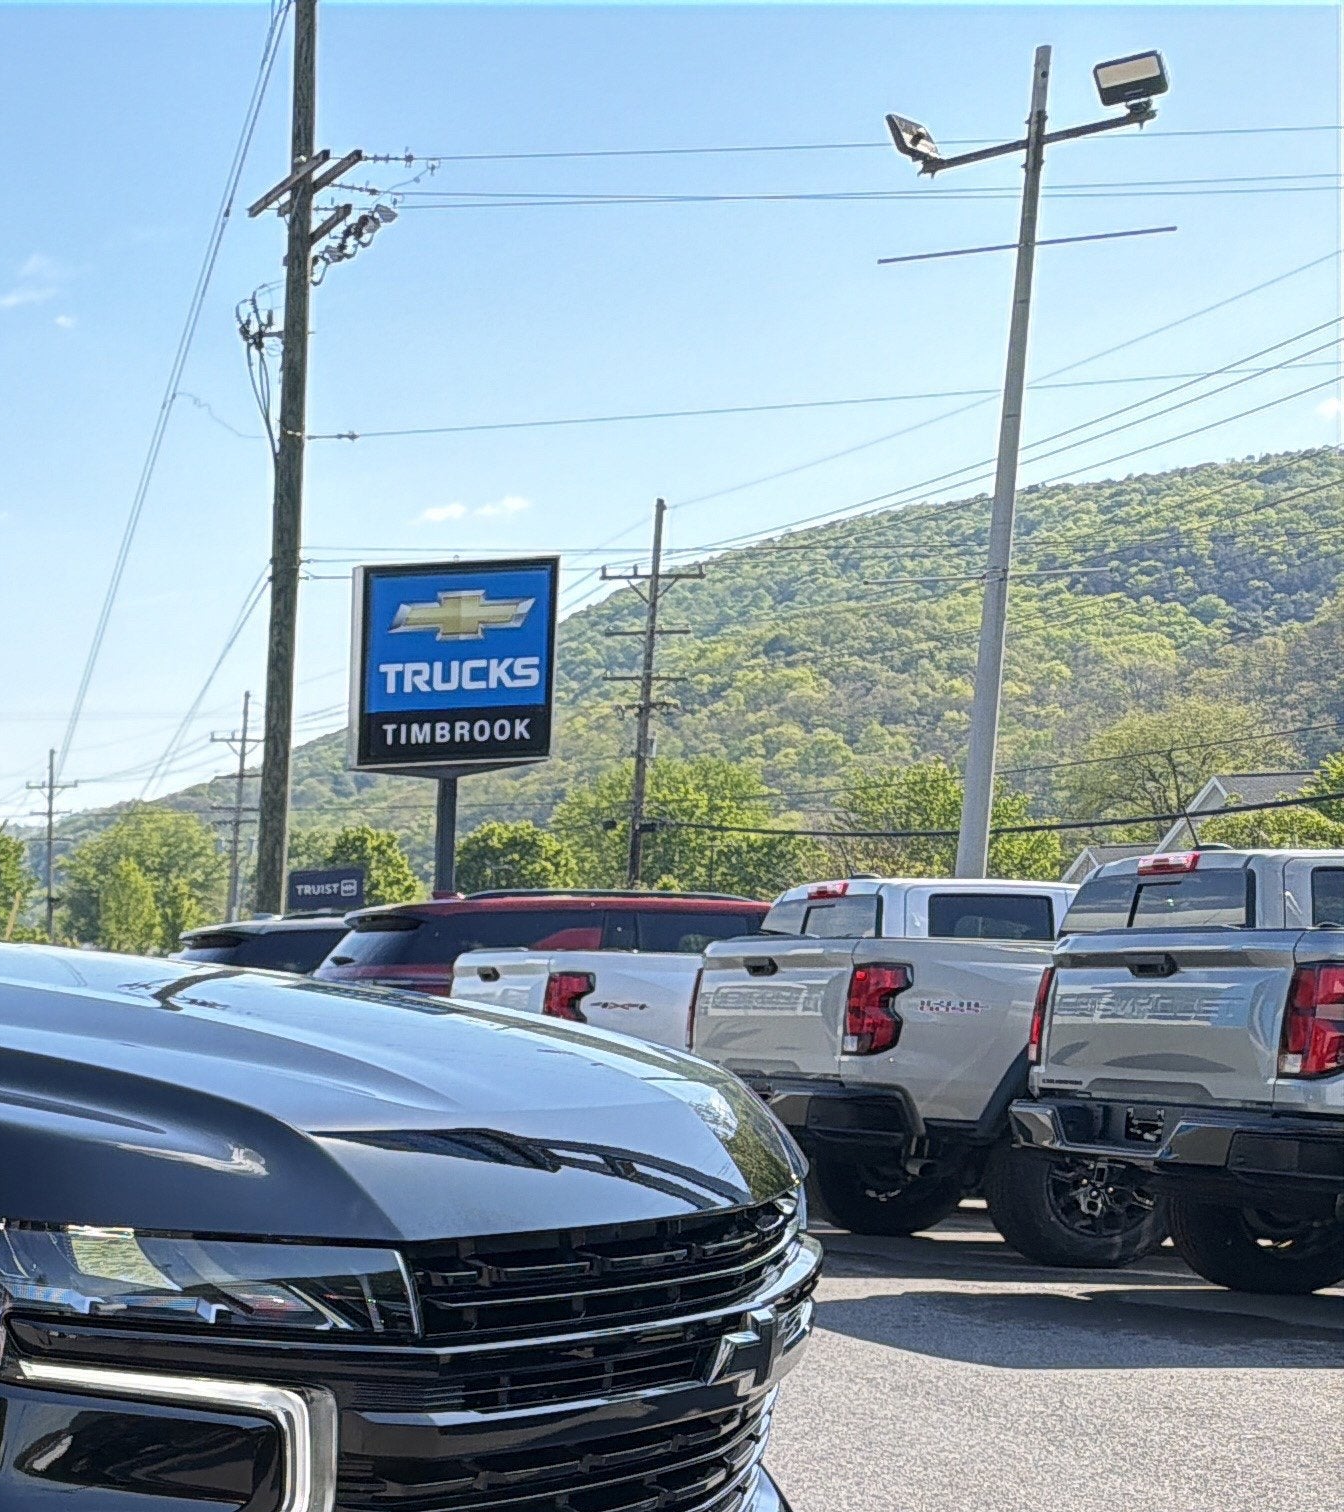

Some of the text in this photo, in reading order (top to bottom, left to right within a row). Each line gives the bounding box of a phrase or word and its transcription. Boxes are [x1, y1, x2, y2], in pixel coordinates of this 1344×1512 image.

[378, 656, 540, 694] TRUCKS
[382, 718, 531, 746] TIMBROOK
[295, 882, 340, 897] TRUIST
